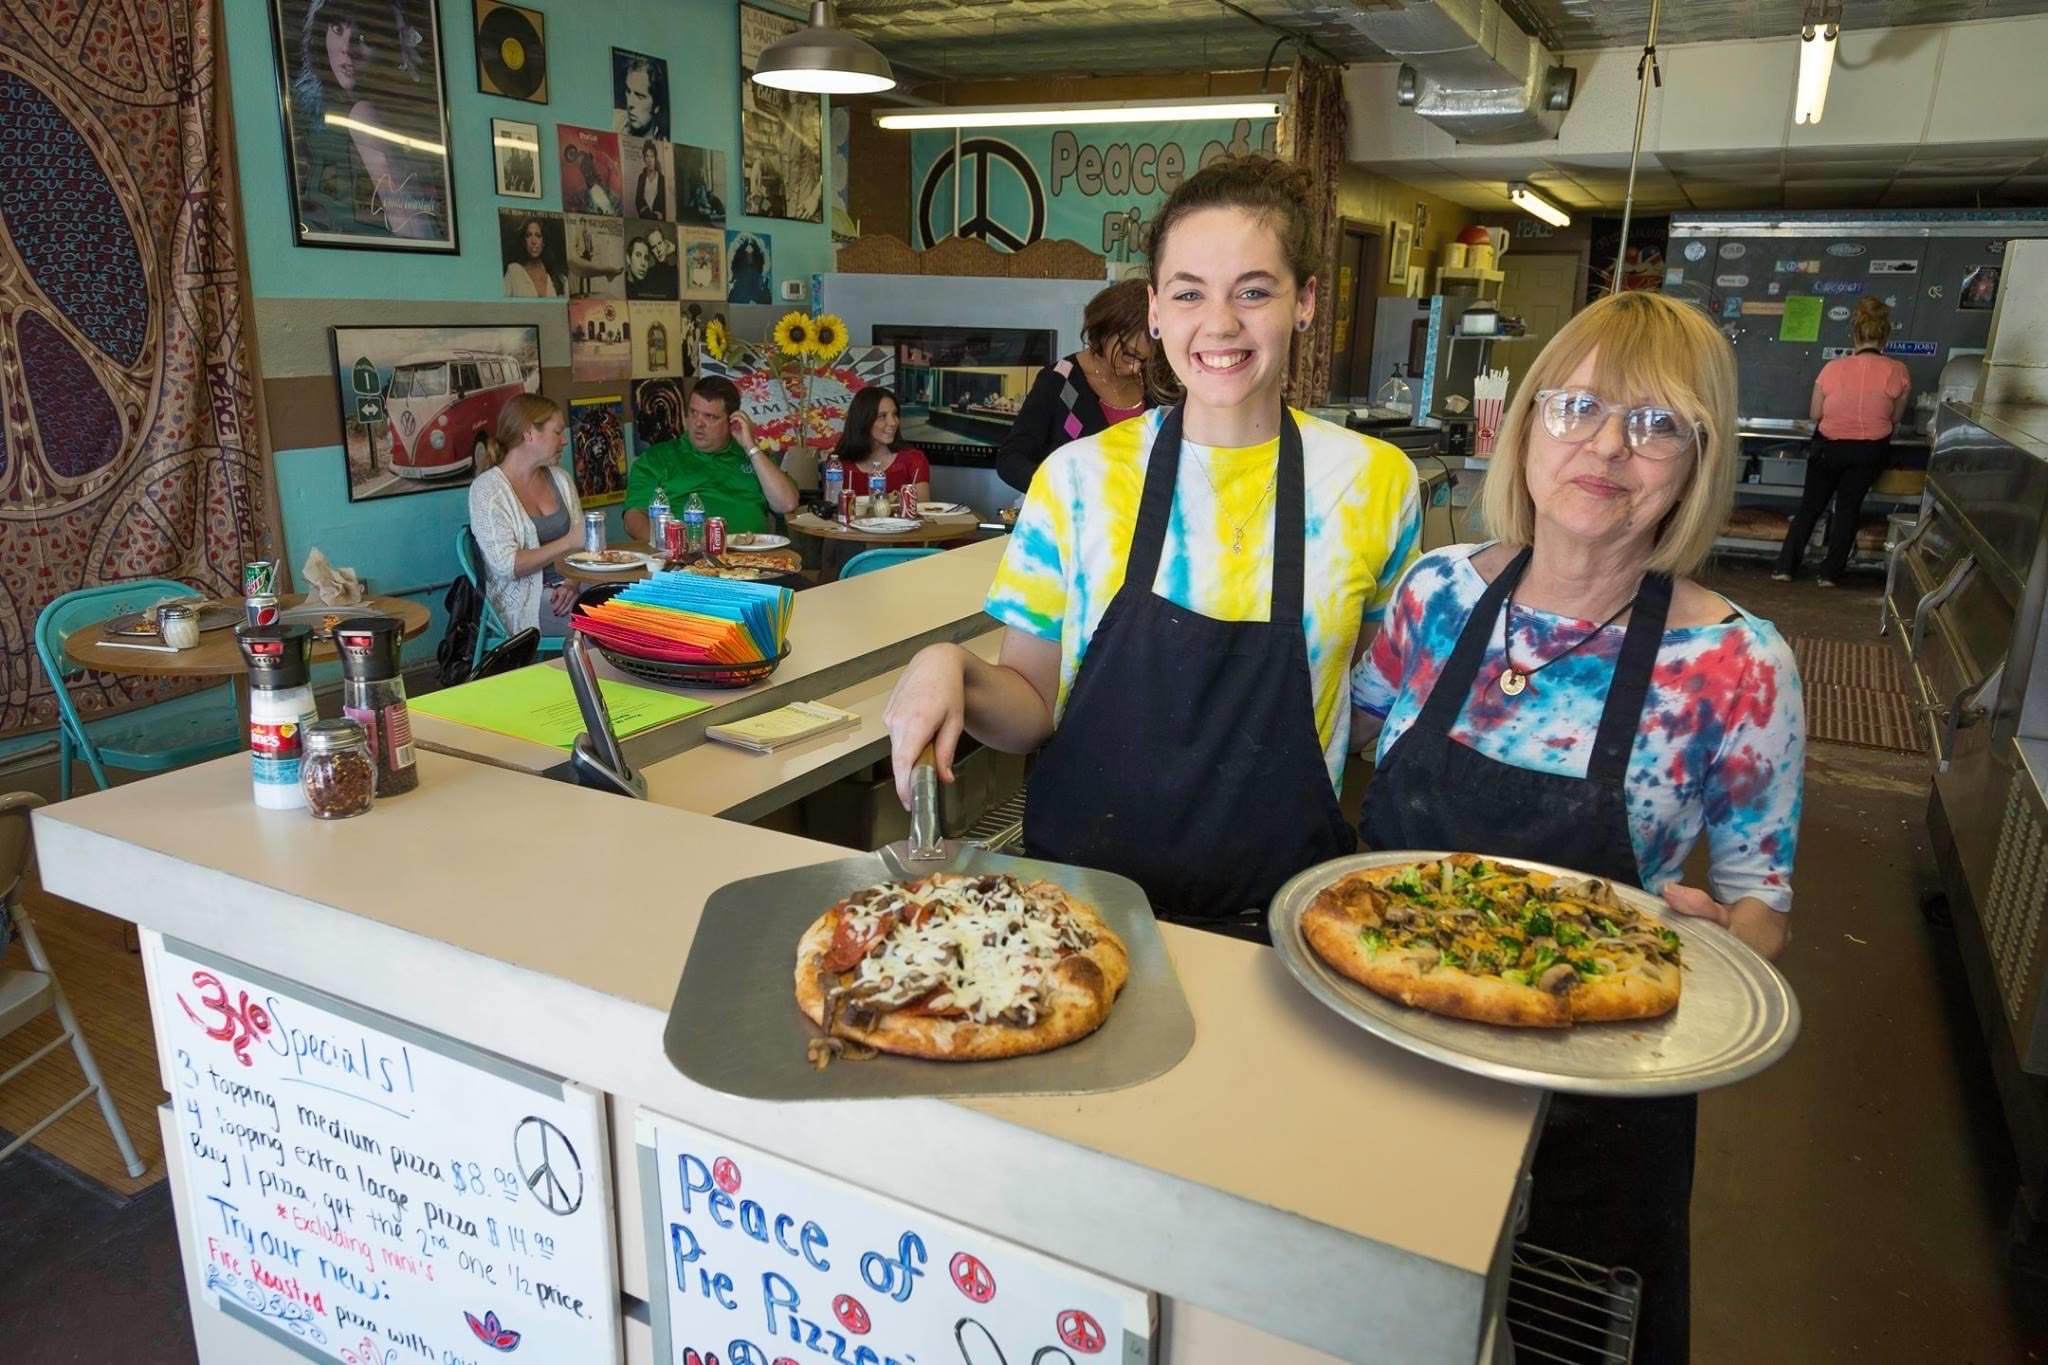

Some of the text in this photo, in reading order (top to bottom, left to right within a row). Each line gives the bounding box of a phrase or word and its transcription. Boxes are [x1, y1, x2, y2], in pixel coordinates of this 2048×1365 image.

[174, 36, 196, 108] PEACE
[1050, 130, 1185, 197] Peace
[207, 363, 237, 436] PEACE
[233, 484, 252, 543] PEACE
[713, 527, 721, 552] Team
[266, 997, 415, 1112] Specials!
[178, 1049, 200, 1089] 3
[208, 1064, 281, 1134] topping
[297, 1104, 382, 1157] medium
[391, 1146, 445, 1182] pizza
[187, 1098, 202, 1129] 4
[295, 1146, 348, 1182] extra
[357, 1165, 409, 1222] large
[424, 1202, 479, 1239] pizza
[190, 1132, 231, 1188] Buy
[368, 1208, 404, 1242] the
[416, 1228, 449, 1257] 2nd
[458, 1251, 497, 1285] one
[207, 1195, 255, 1255] Try
[261, 1231, 301, 1267] our
[381, 1247, 434, 1282] mini's
[670, 1223, 738, 1310] Pie
[678, 1153, 928, 1303] Peace of
[208, 1237, 242, 1276] Fire
[250, 1259, 328, 1316] Roasted
[336, 1306, 378, 1330] pizza
[388, 1328, 434, 1360] with
